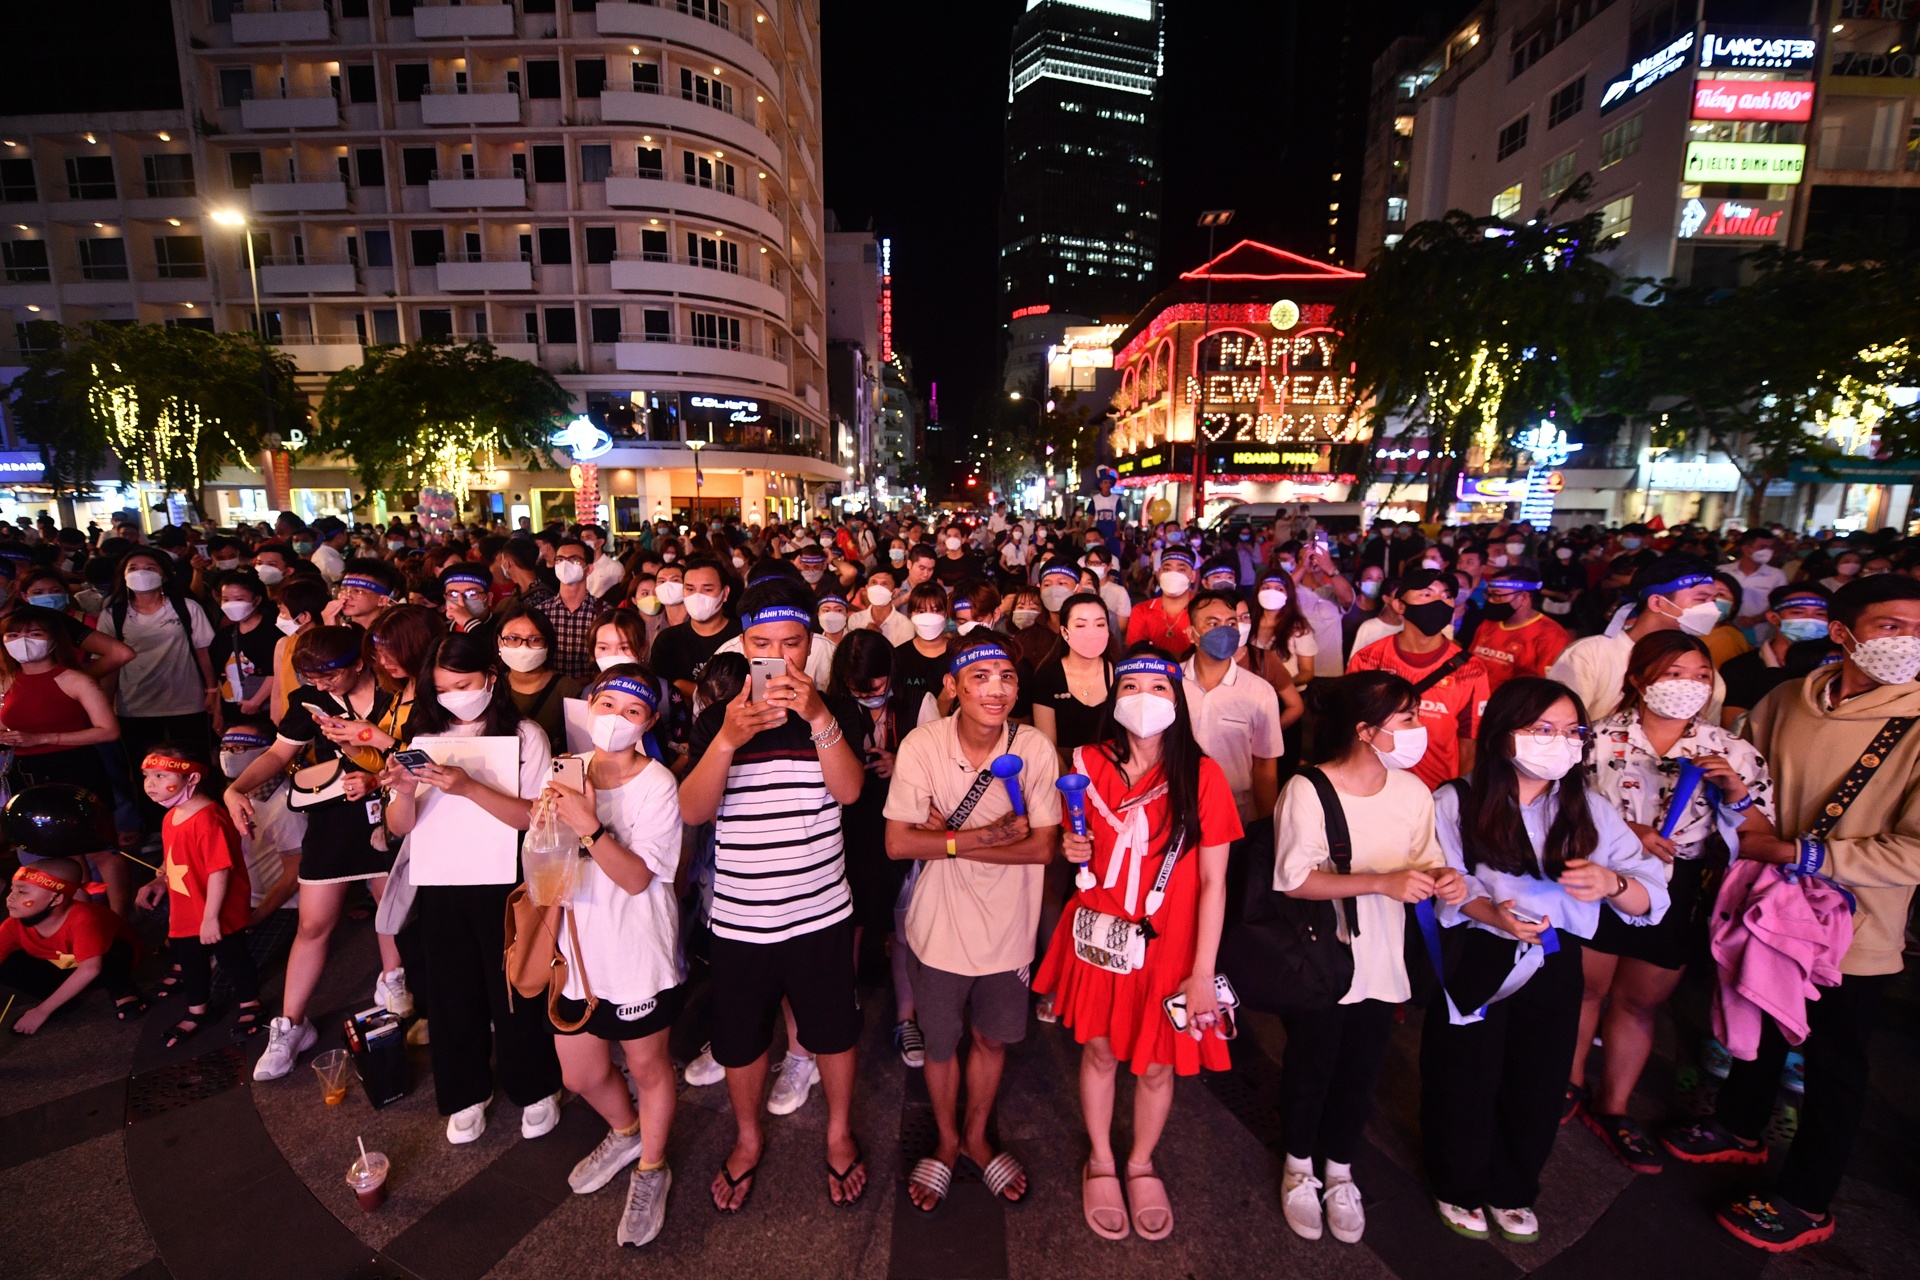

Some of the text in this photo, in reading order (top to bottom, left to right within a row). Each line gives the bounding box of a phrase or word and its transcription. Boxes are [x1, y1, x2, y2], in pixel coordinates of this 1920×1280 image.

[1715, 37, 1815, 58] LANCASTER
[883, 238, 891, 275] HOTEL
[1219, 335, 1335, 367] HAPPY
[1185, 375, 1262, 404] NEW
[1235, 412, 1316, 442] 2022
[980, 648, 994, 657] NAM
[1475, 645, 1515, 662] HONDA
[618, 1000, 654, 1016] ERROR
